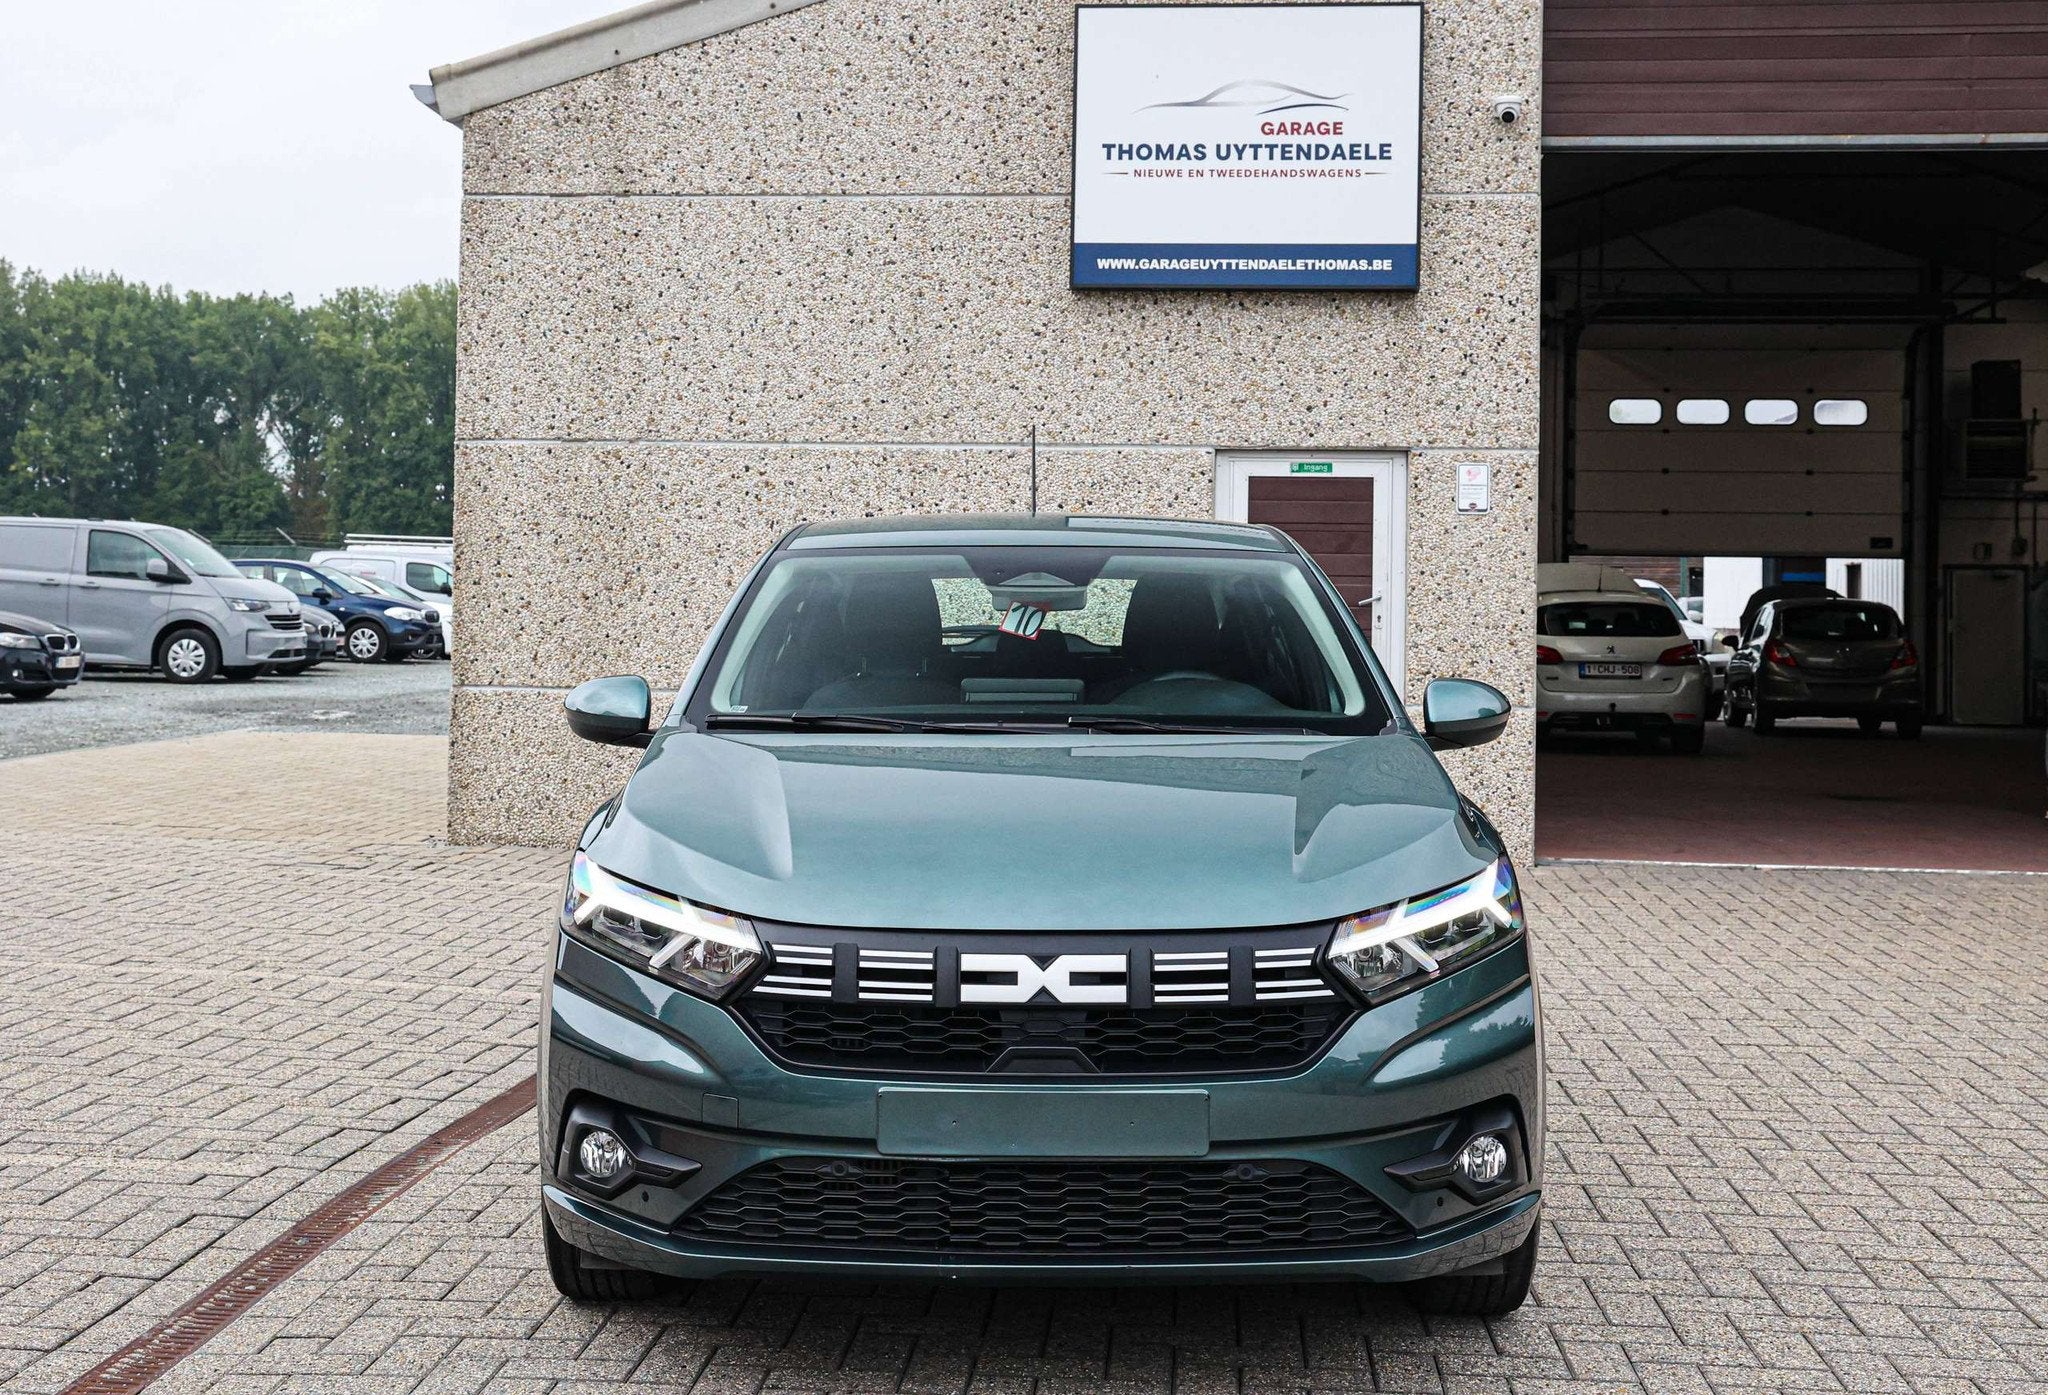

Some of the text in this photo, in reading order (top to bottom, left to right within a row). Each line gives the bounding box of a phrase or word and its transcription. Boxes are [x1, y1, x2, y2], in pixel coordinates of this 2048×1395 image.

[1261, 121, 1343, 135] GARAGE
[1102, 143, 1392, 160] THOMAS UYTTENDAELE
[1133, 169, 1361, 178] NIEUWE EN TWEEDEHANDSWAGENS
[1097, 258, 1392, 271] WWW.GARAGEUYTTENDAELETHOMAS.BE
[1303, 463, 1328, 472] Ingang
[1012, 604, 1047, 637] 10
